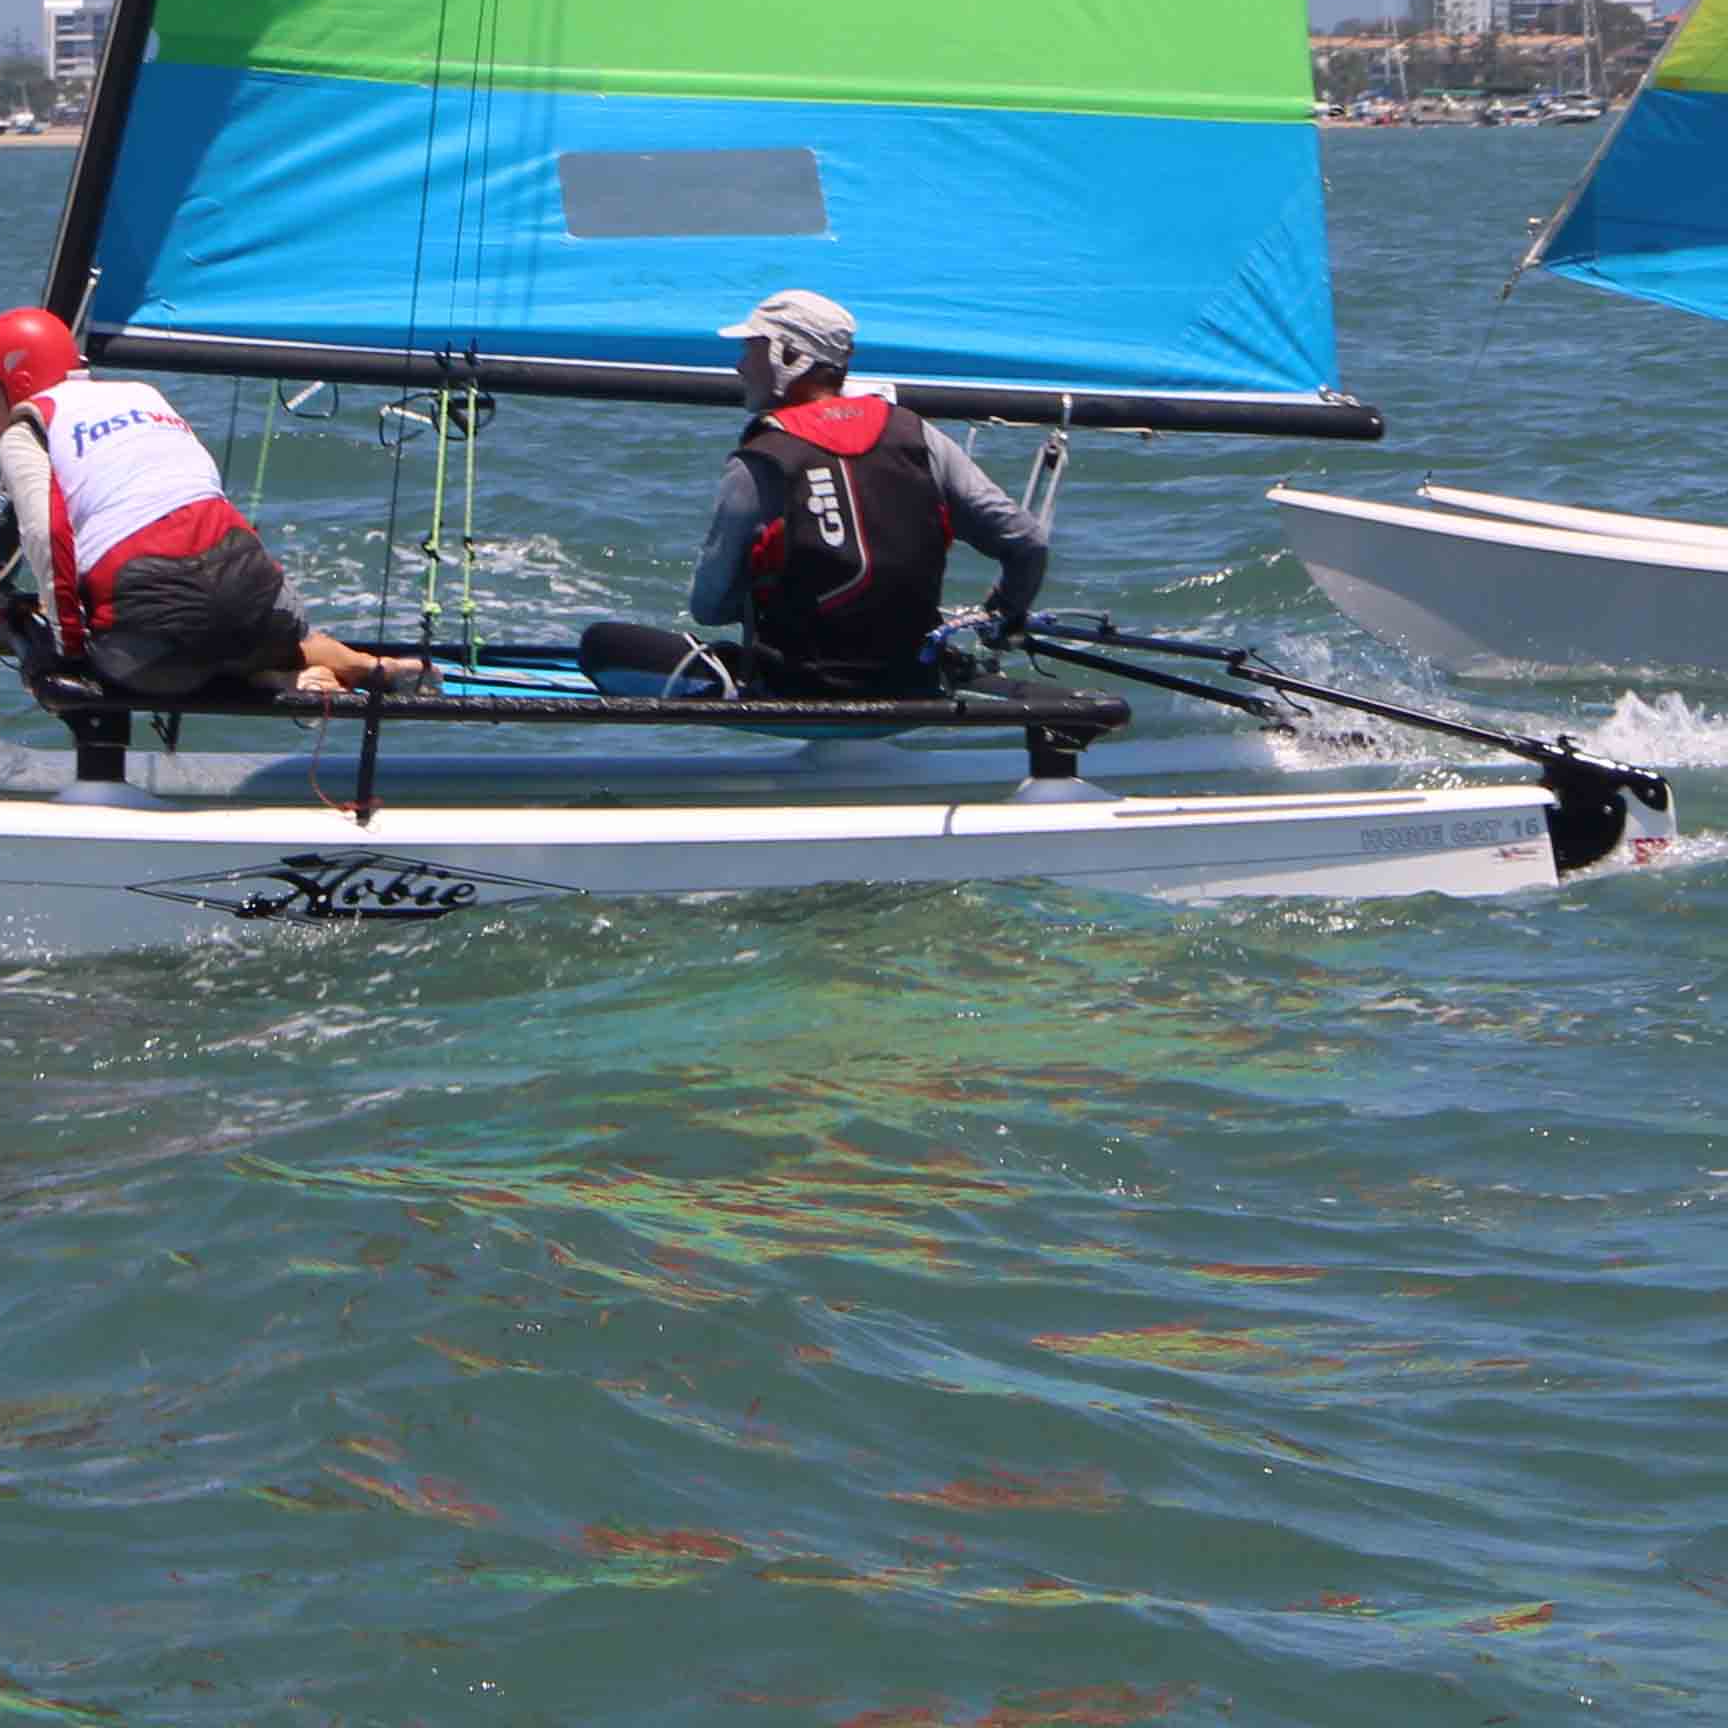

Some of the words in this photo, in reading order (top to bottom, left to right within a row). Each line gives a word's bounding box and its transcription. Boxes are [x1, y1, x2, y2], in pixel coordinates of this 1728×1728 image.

[806, 467, 846, 548] Gill
[1509, 816, 1541, 839] 16
[233, 852, 477, 921] Hobie
